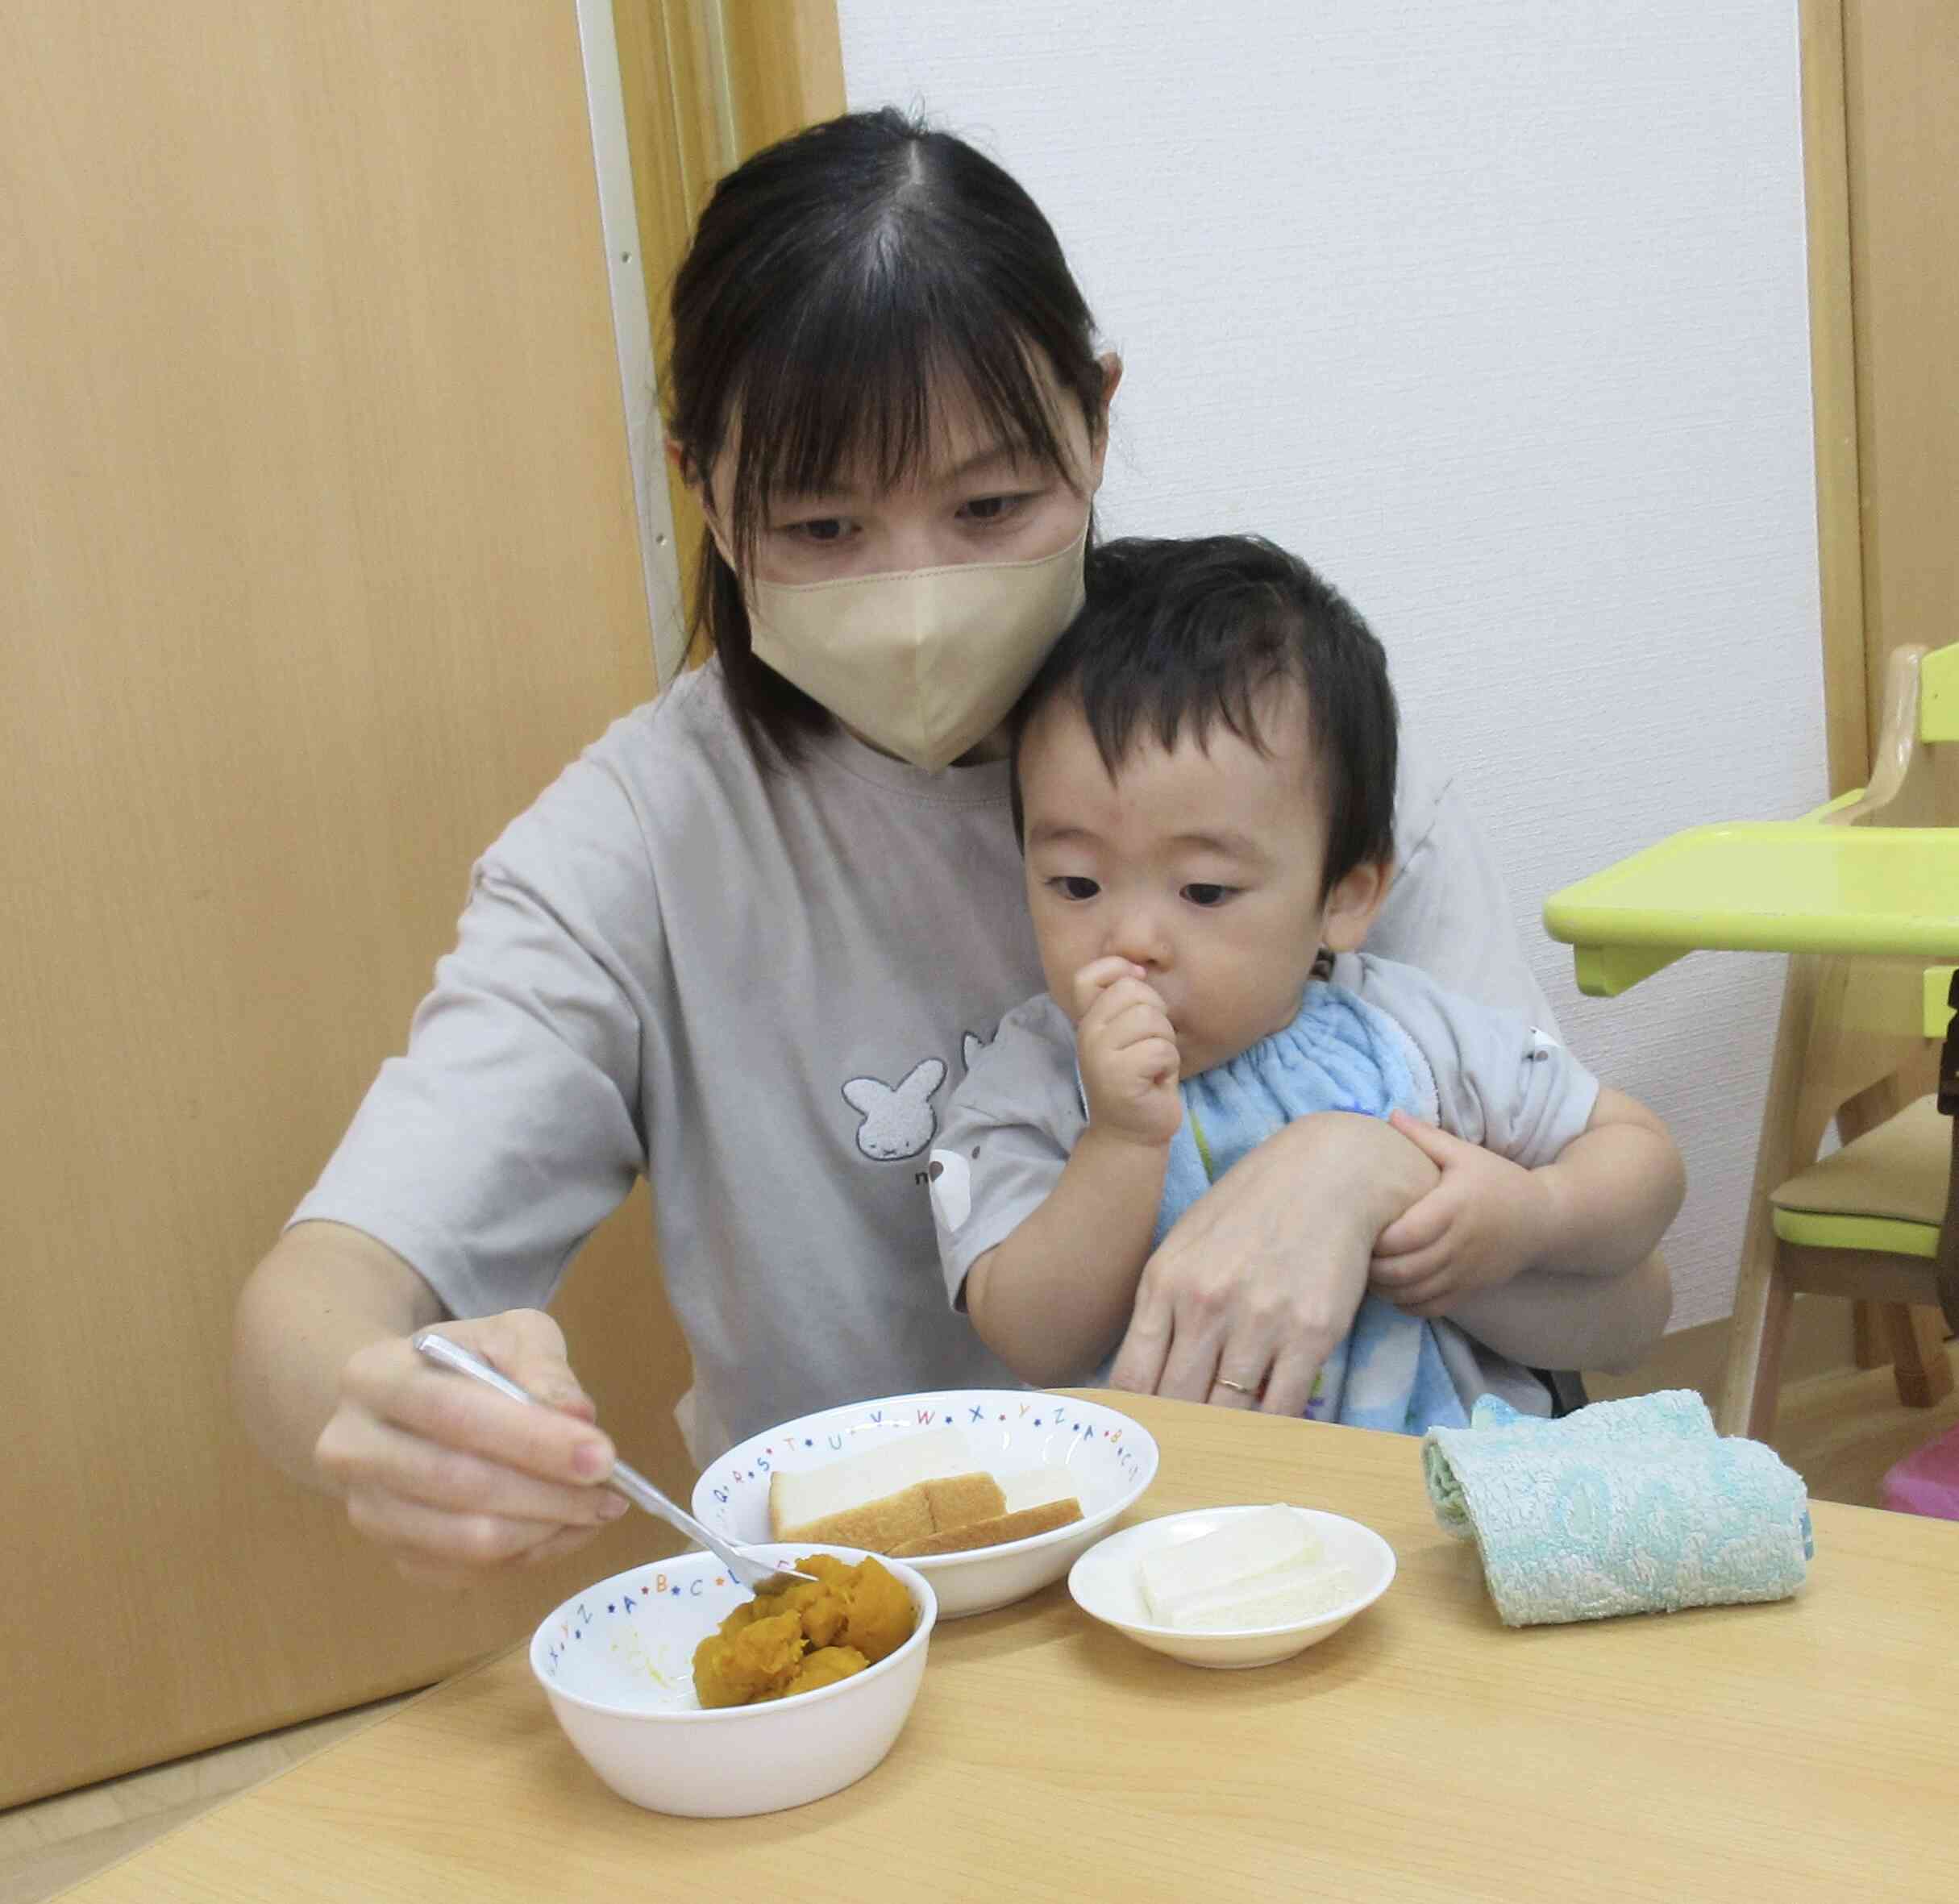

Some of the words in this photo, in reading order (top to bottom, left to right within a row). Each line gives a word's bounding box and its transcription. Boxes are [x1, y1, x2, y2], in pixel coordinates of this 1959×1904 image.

[757, 1457, 770, 1471] S
[783, 1437, 796, 1451] T
[828, 1435, 842, 1450] U
[871, 1411, 883, 1426] V
[917, 1410, 936, 1425] W
[969, 1406, 984, 1423] X
[1019, 1403, 1031, 1418] Y
[1054, 1407, 1065, 1424] Z
[624, 1595, 637, 1615] A
[656, 1574, 668, 1593] B
[690, 1578, 704, 1596] C
